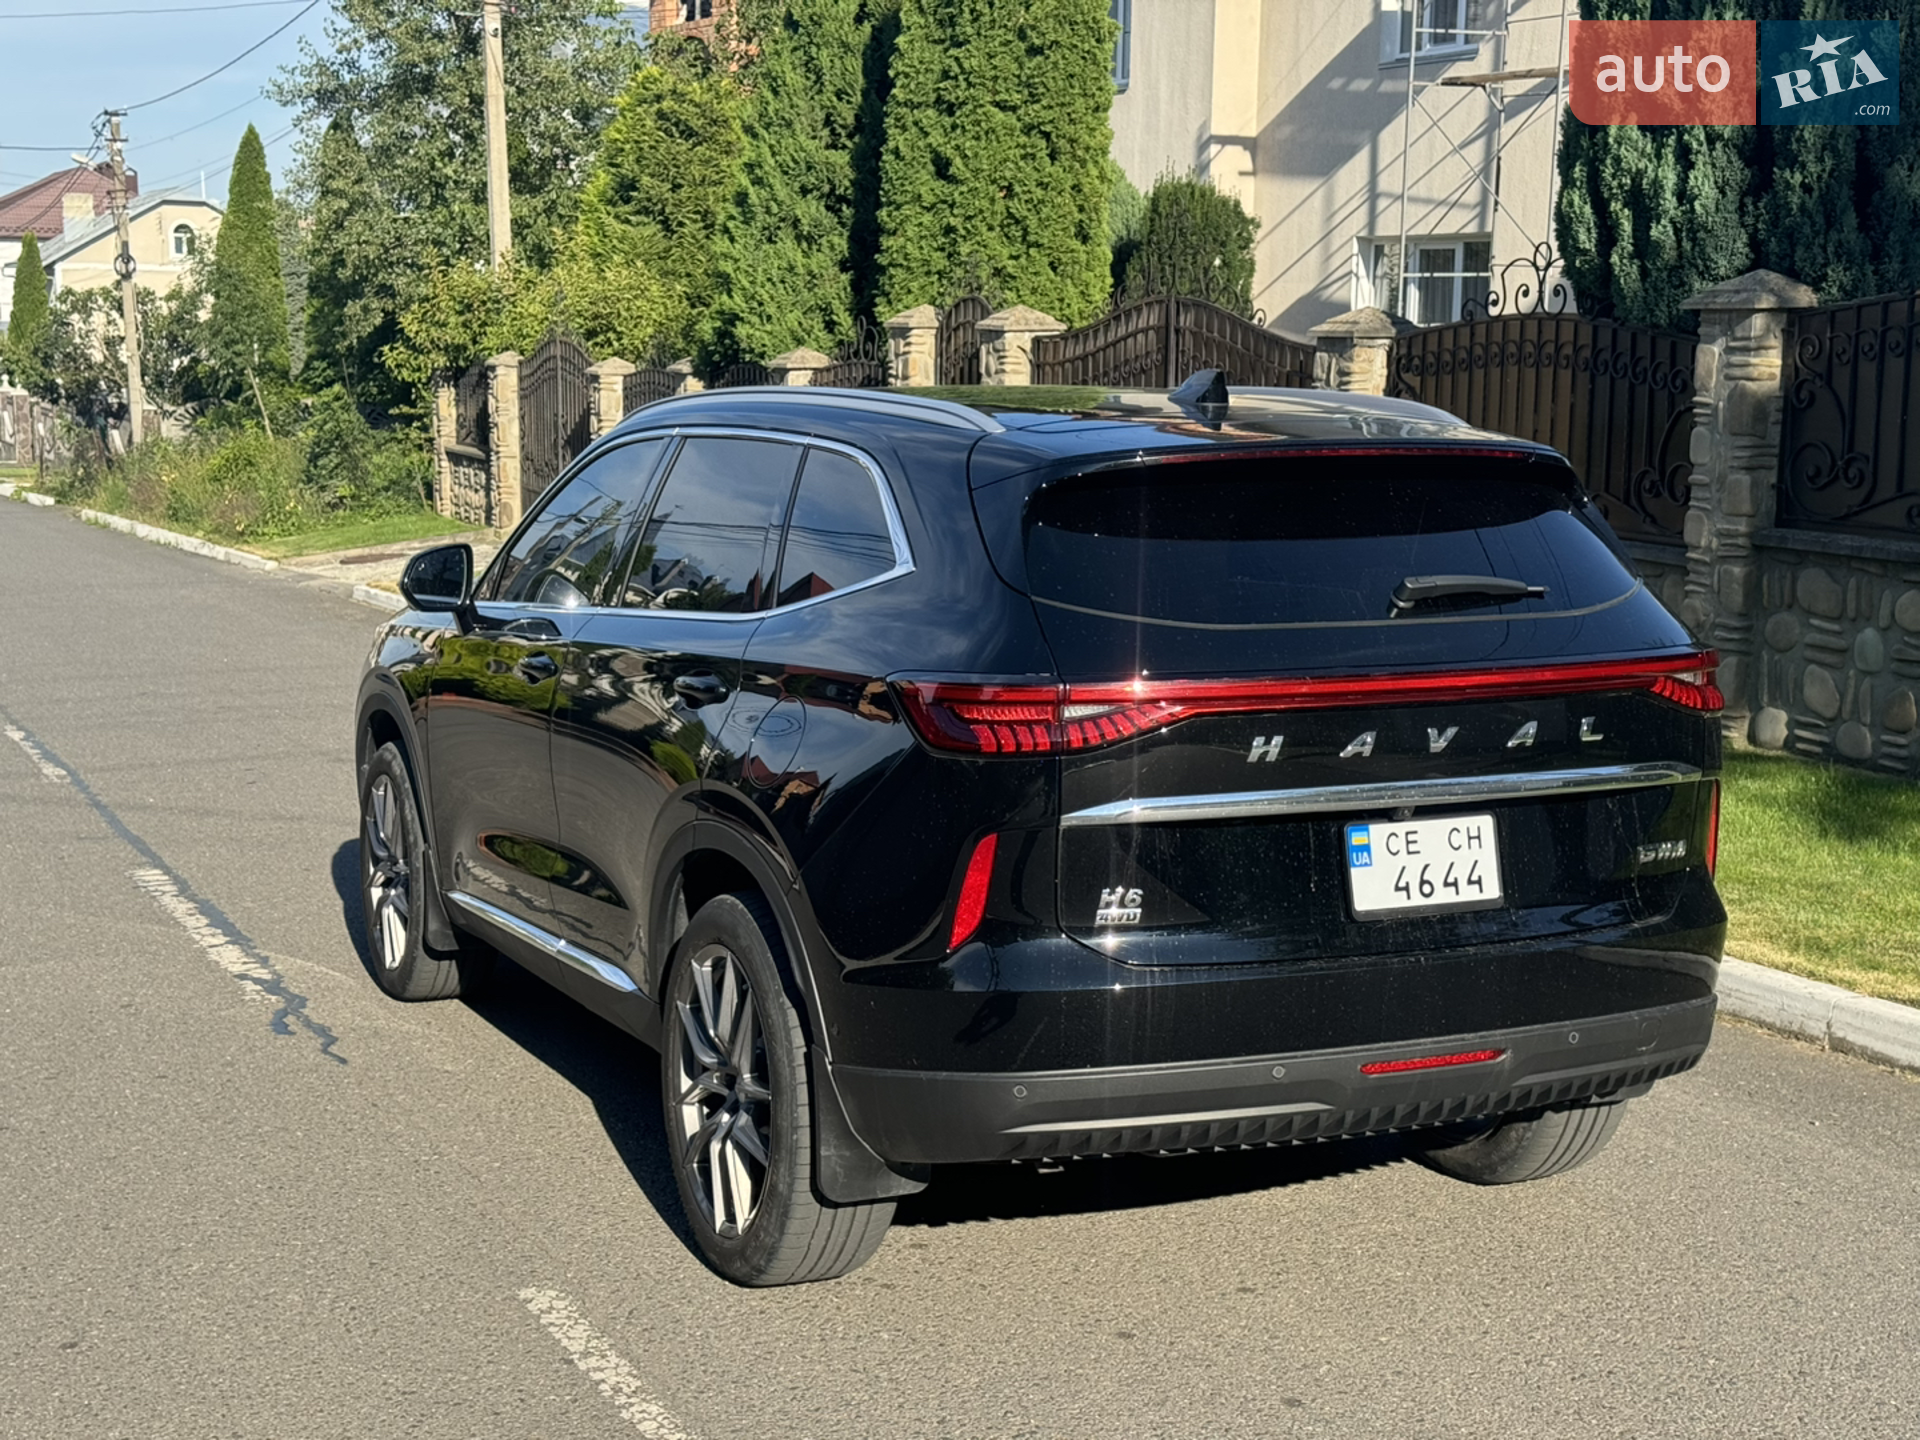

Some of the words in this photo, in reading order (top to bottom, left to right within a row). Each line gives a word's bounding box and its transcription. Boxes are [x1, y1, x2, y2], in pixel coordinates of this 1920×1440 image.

[1246, 715, 1604, 763] HAVAL
[1386, 830, 1421, 856] CE
[1448, 825, 1482, 851] CH
[1352, 851, 1371, 866] UA
[1394, 859, 1484, 900] 4644
[1099, 886, 1143, 908] H6
